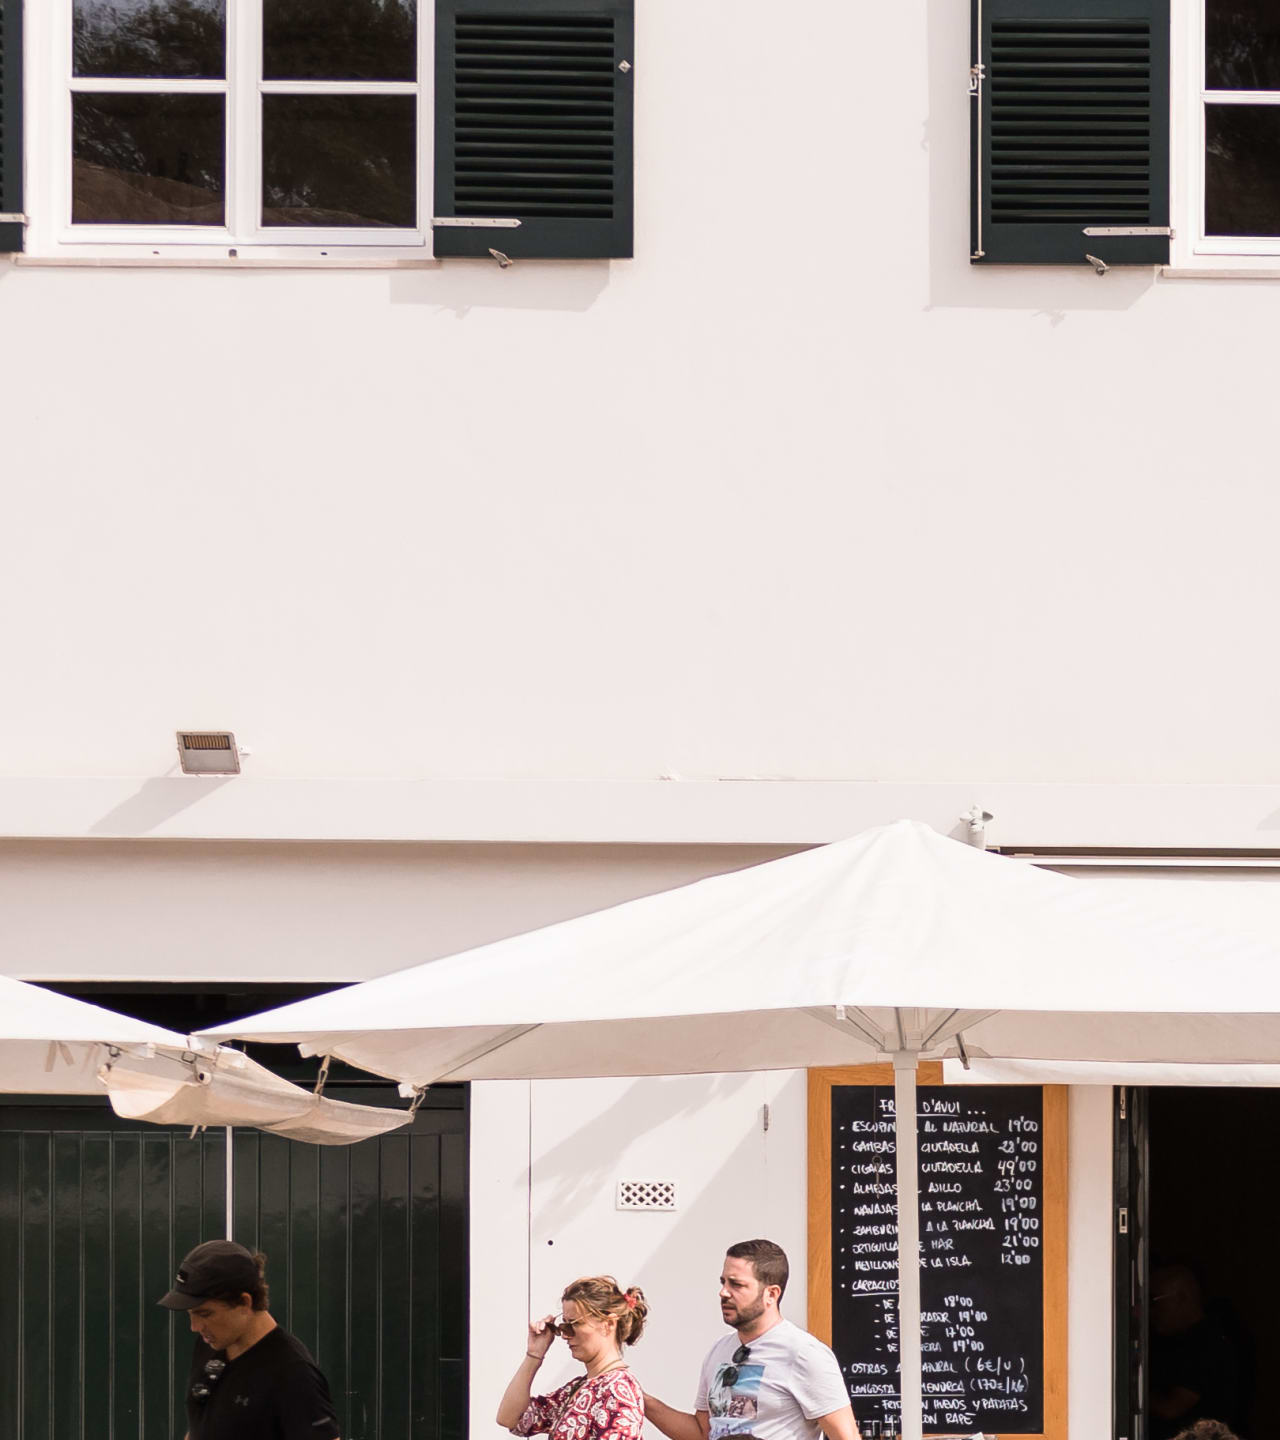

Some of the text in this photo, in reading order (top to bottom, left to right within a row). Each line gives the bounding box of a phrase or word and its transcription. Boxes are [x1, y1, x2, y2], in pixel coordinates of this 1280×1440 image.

[924, 1120, 938, 1133] AL
[943, 1120, 1000, 1134] NATURAL
[1008, 1115, 1039, 1133] 19'00
[852, 1140, 897, 1154] GAMBAS
[997, 1155, 1037, 1176] 49'00
[993, 1176, 1033, 1193] 23'00
[854, 1193, 1037, 1217] NAVAJAS LA PLANCHA 19'00
[925, 1221, 934, 1232] A
[936, 1220, 949, 1233] LA
[1004, 1212, 1040, 1232] 19'00
[1002, 1232, 1040, 1248] 21'00
[930, 1257, 943, 1268] LA
[946, 1254, 973, 1268] ISLA
[1001, 1249, 1032, 1266] 12'00
[943, 1294, 974, 1308] 18'00
[958, 1308, 988, 1323] 19'00
[945, 1323, 976, 1339] 17'00
[952, 1338, 985, 1353] 19'00
[850, 1362, 889, 1377] OSTRAS
[921, 1360, 959, 1374] ATURAL
[850, 1382, 897, 1395] LANGOSTA
[982, 1397, 1029, 1413] PATATAS
